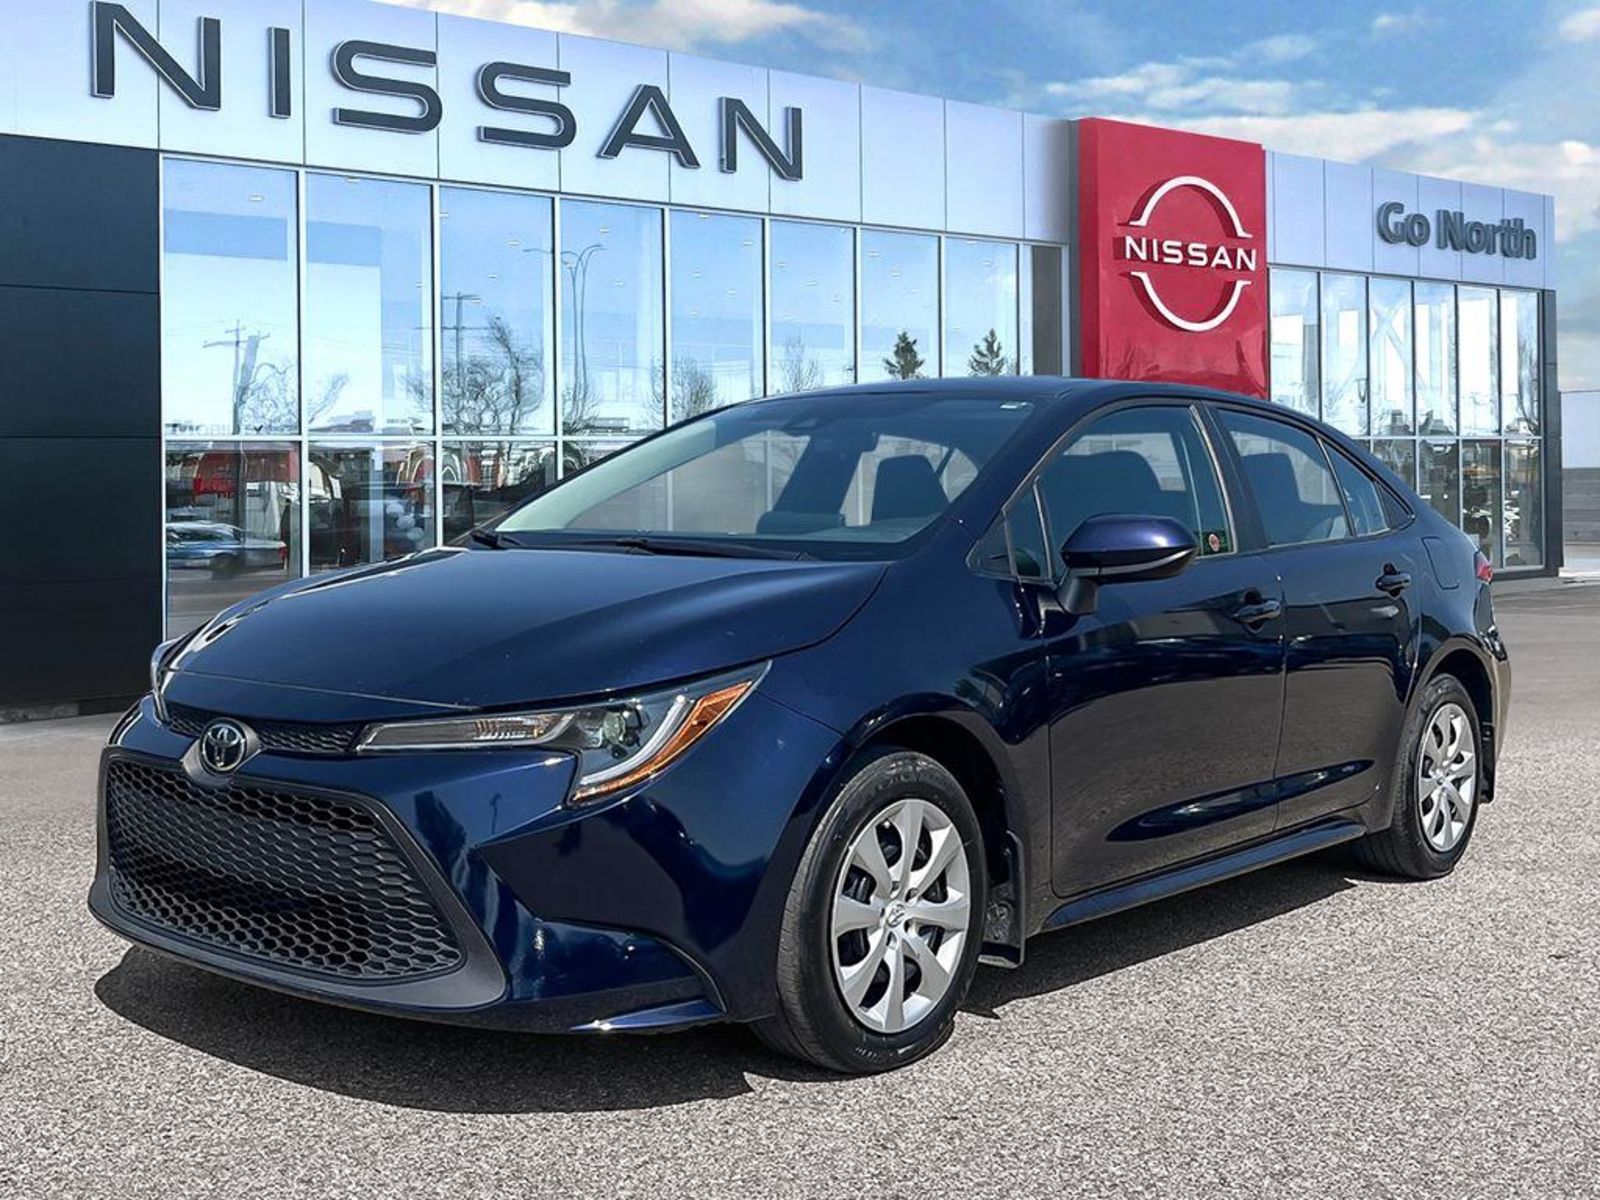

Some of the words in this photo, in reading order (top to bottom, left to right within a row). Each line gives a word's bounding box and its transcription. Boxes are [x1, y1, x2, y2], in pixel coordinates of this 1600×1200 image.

[91, 1, 803, 182] NISSAN
[1125, 235, 1257, 271] NISSAN
[1377, 202, 1430, 247] Go
[1436, 208, 1537, 260] North
